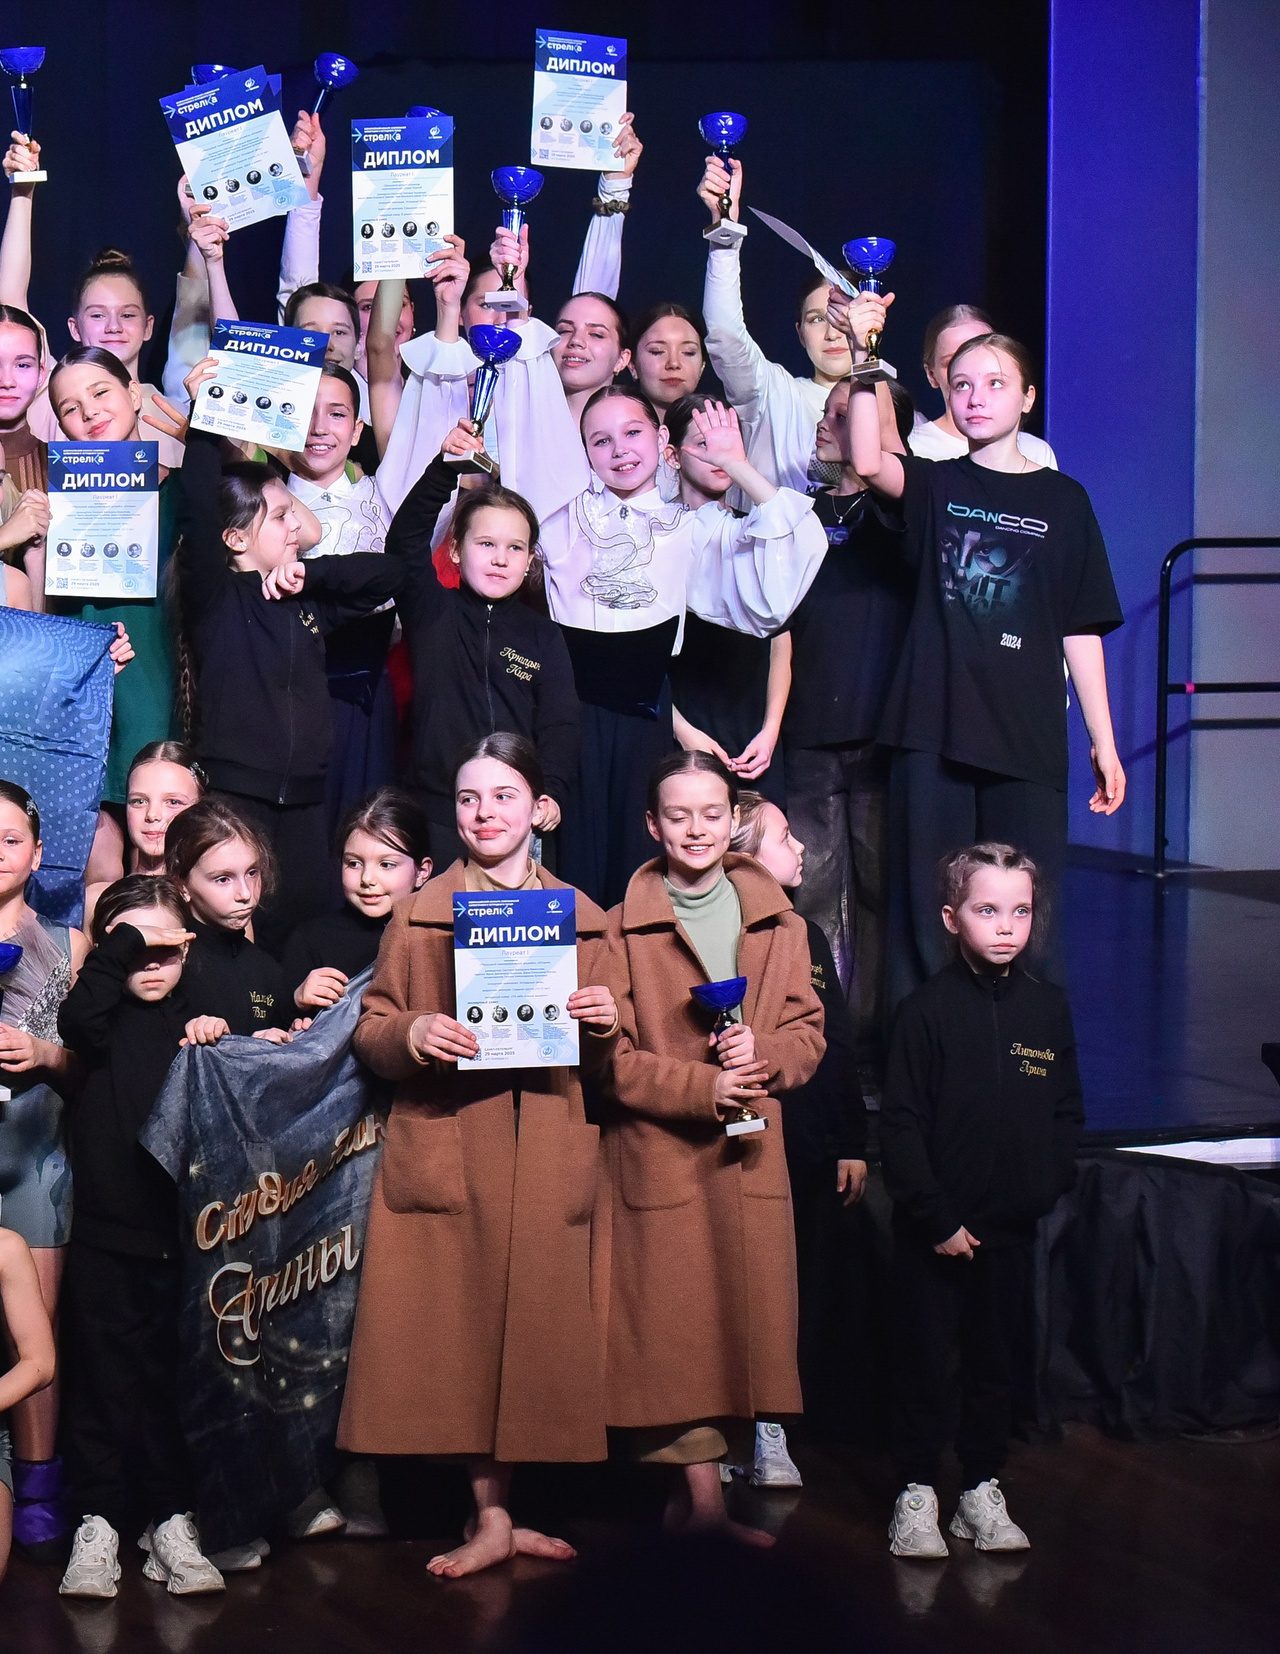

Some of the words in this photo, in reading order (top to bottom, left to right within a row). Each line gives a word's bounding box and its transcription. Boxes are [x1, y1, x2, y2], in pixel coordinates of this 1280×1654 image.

[546, 56, 615, 76] ДИПЛОМ
[185, 98, 264, 139] ДИПЛОМ
[364, 149, 440, 169] ДИПЛОМ
[224, 339, 310, 362] ДИПЛОМ
[62, 473, 145, 490] ДИПЛОМ
[947, 502, 1048, 532] DANCO
[1000, 633, 1022, 650] 2024
[506, 664, 532, 681] Кира
[469, 925, 560, 946] ДИПЛОМ
[1010, 1042, 1055, 1060] Антонова
[1020, 1060, 1047, 1076] Арина
